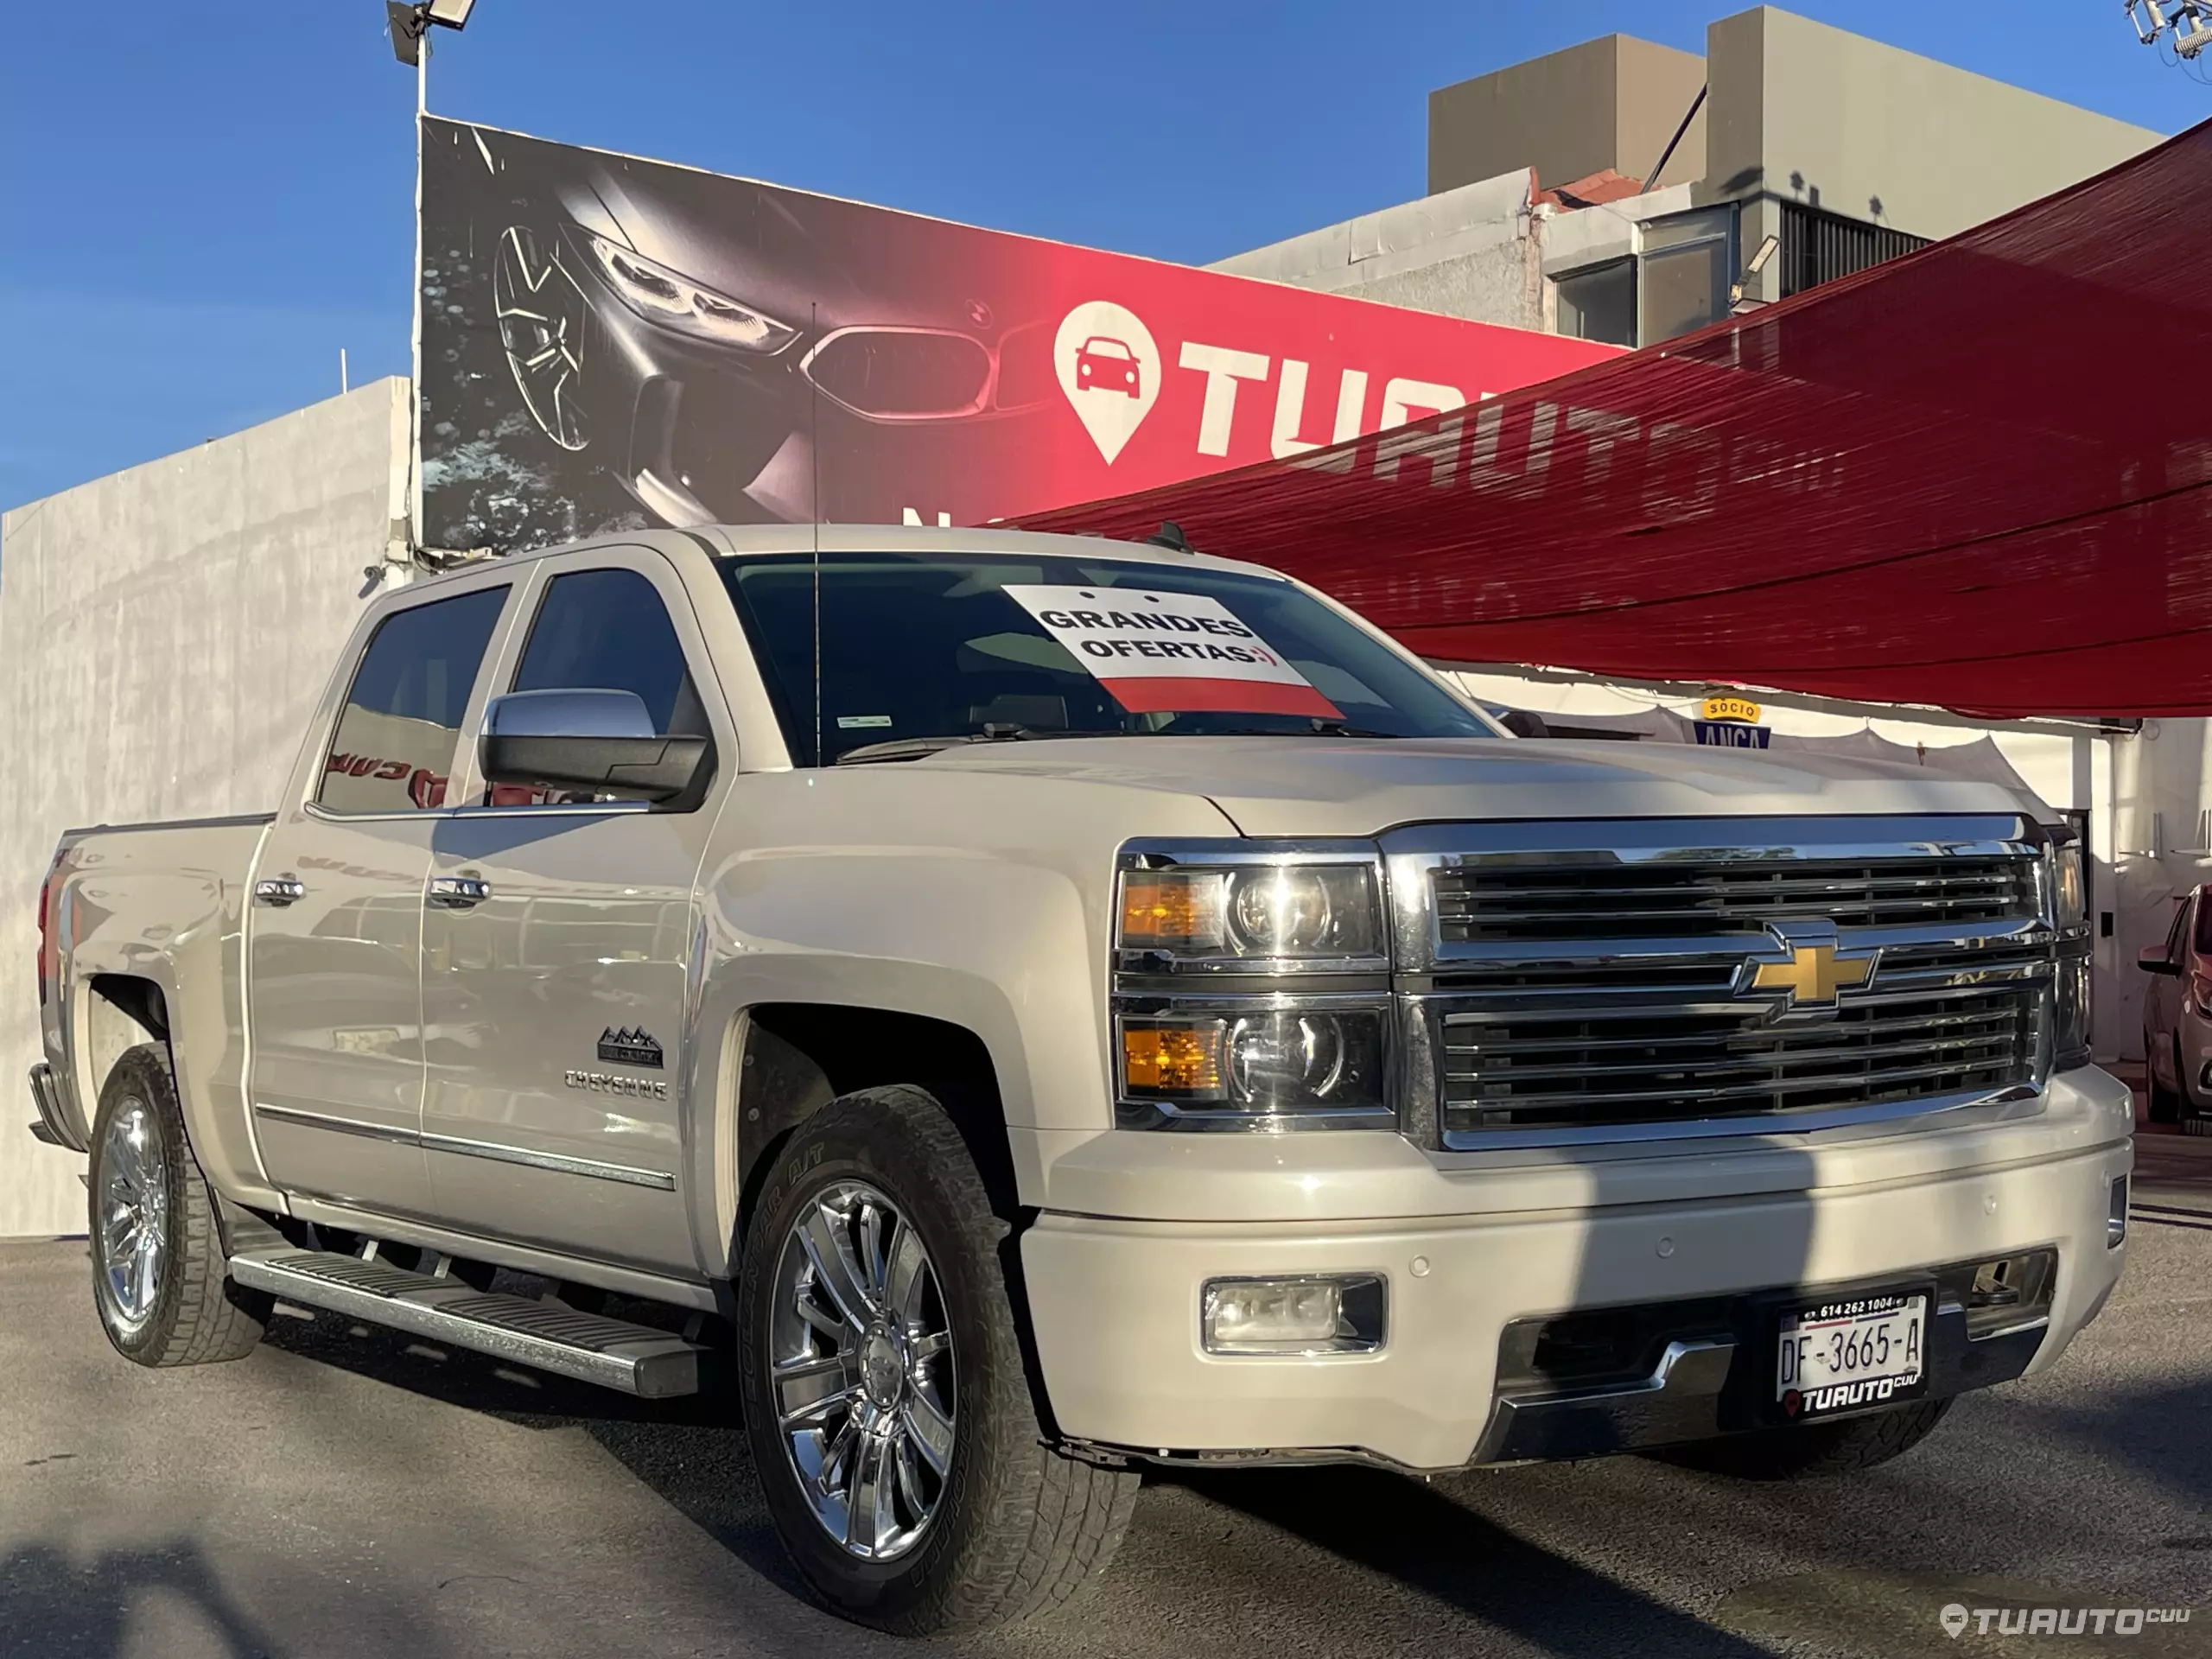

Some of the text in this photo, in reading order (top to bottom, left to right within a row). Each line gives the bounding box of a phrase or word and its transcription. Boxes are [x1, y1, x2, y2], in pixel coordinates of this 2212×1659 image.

[1039, 610, 1253, 638] GRANDES
[1710, 702, 1754, 716] SOCIO
[1706, 726, 1760, 749] ANCA
[564, 1071, 667, 1102] CHEYENNE
[788, 1141, 825, 1185] A/T
[1821, 1297, 1892, 1317] 614 262 1004
[1782, 1318, 1918, 1384] DF-3665-A
[1802, 1377, 1893, 1412] TUAUTO
